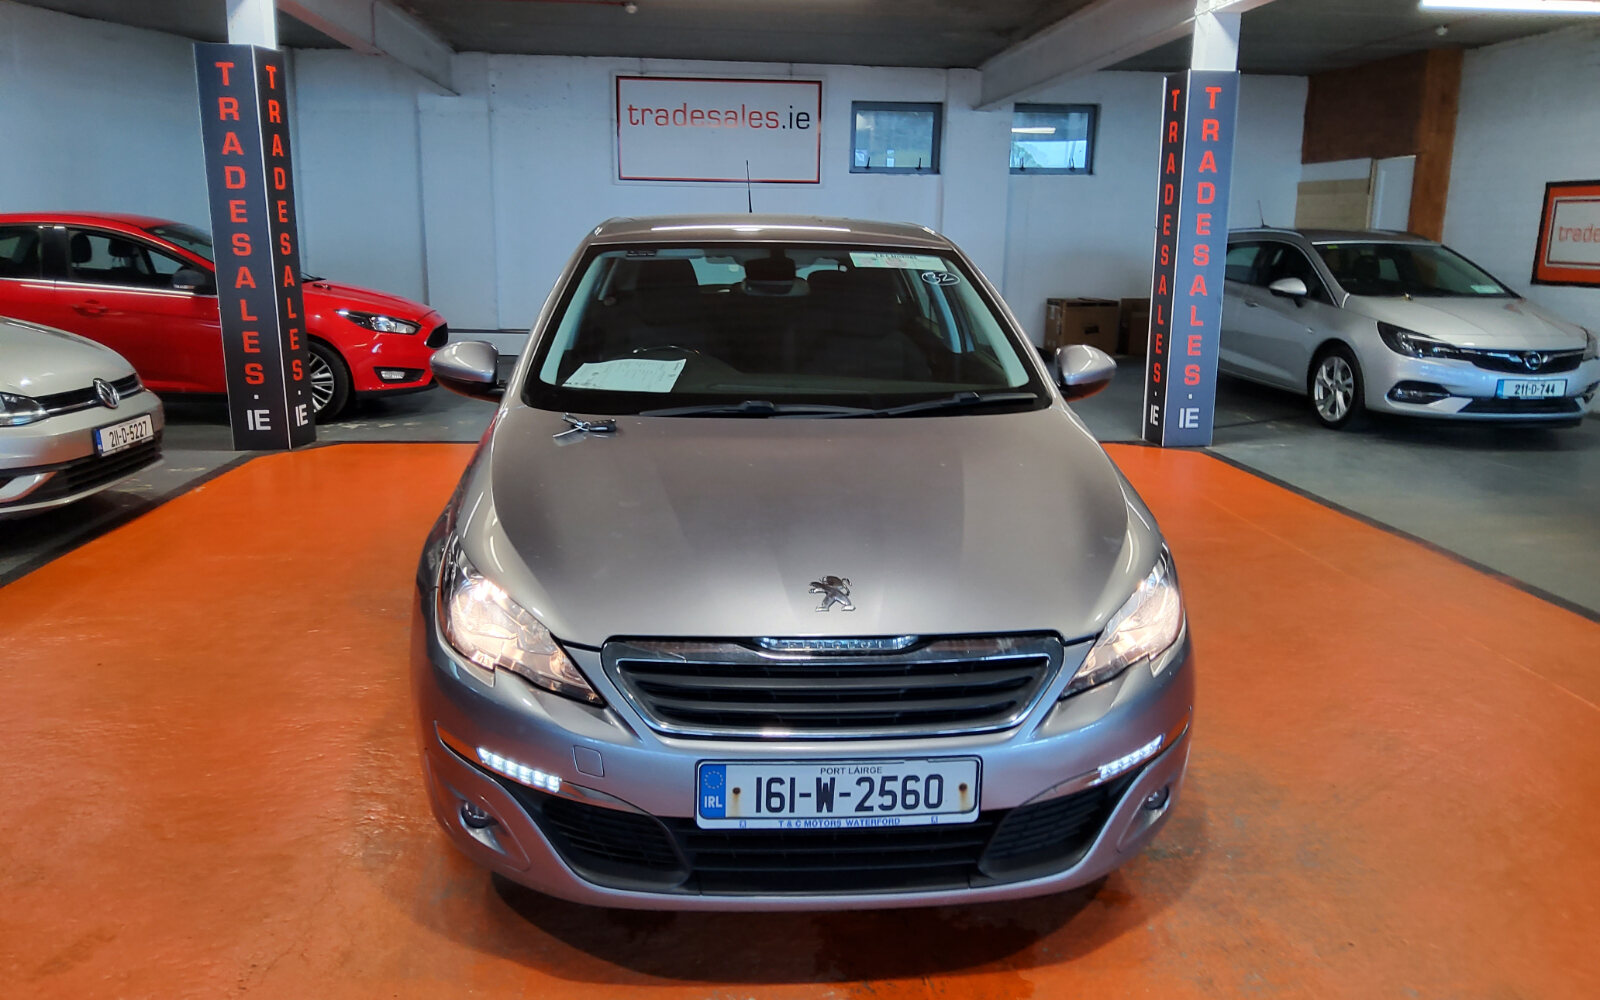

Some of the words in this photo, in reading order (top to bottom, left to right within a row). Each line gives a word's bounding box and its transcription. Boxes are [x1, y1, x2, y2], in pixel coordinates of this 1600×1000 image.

[627, 102, 811, 130] tradesales.ie
[109, 420, 147, 447] 211-D-5227
[820, 766, 846, 775] PORT
[703, 795, 723, 809] IRL
[755, 774, 944, 813] 161-W-2560
[778, 820, 784, 828] T
[803, 819, 842, 828] MOTORS
[845, 817, 901, 826] WATERFORD
